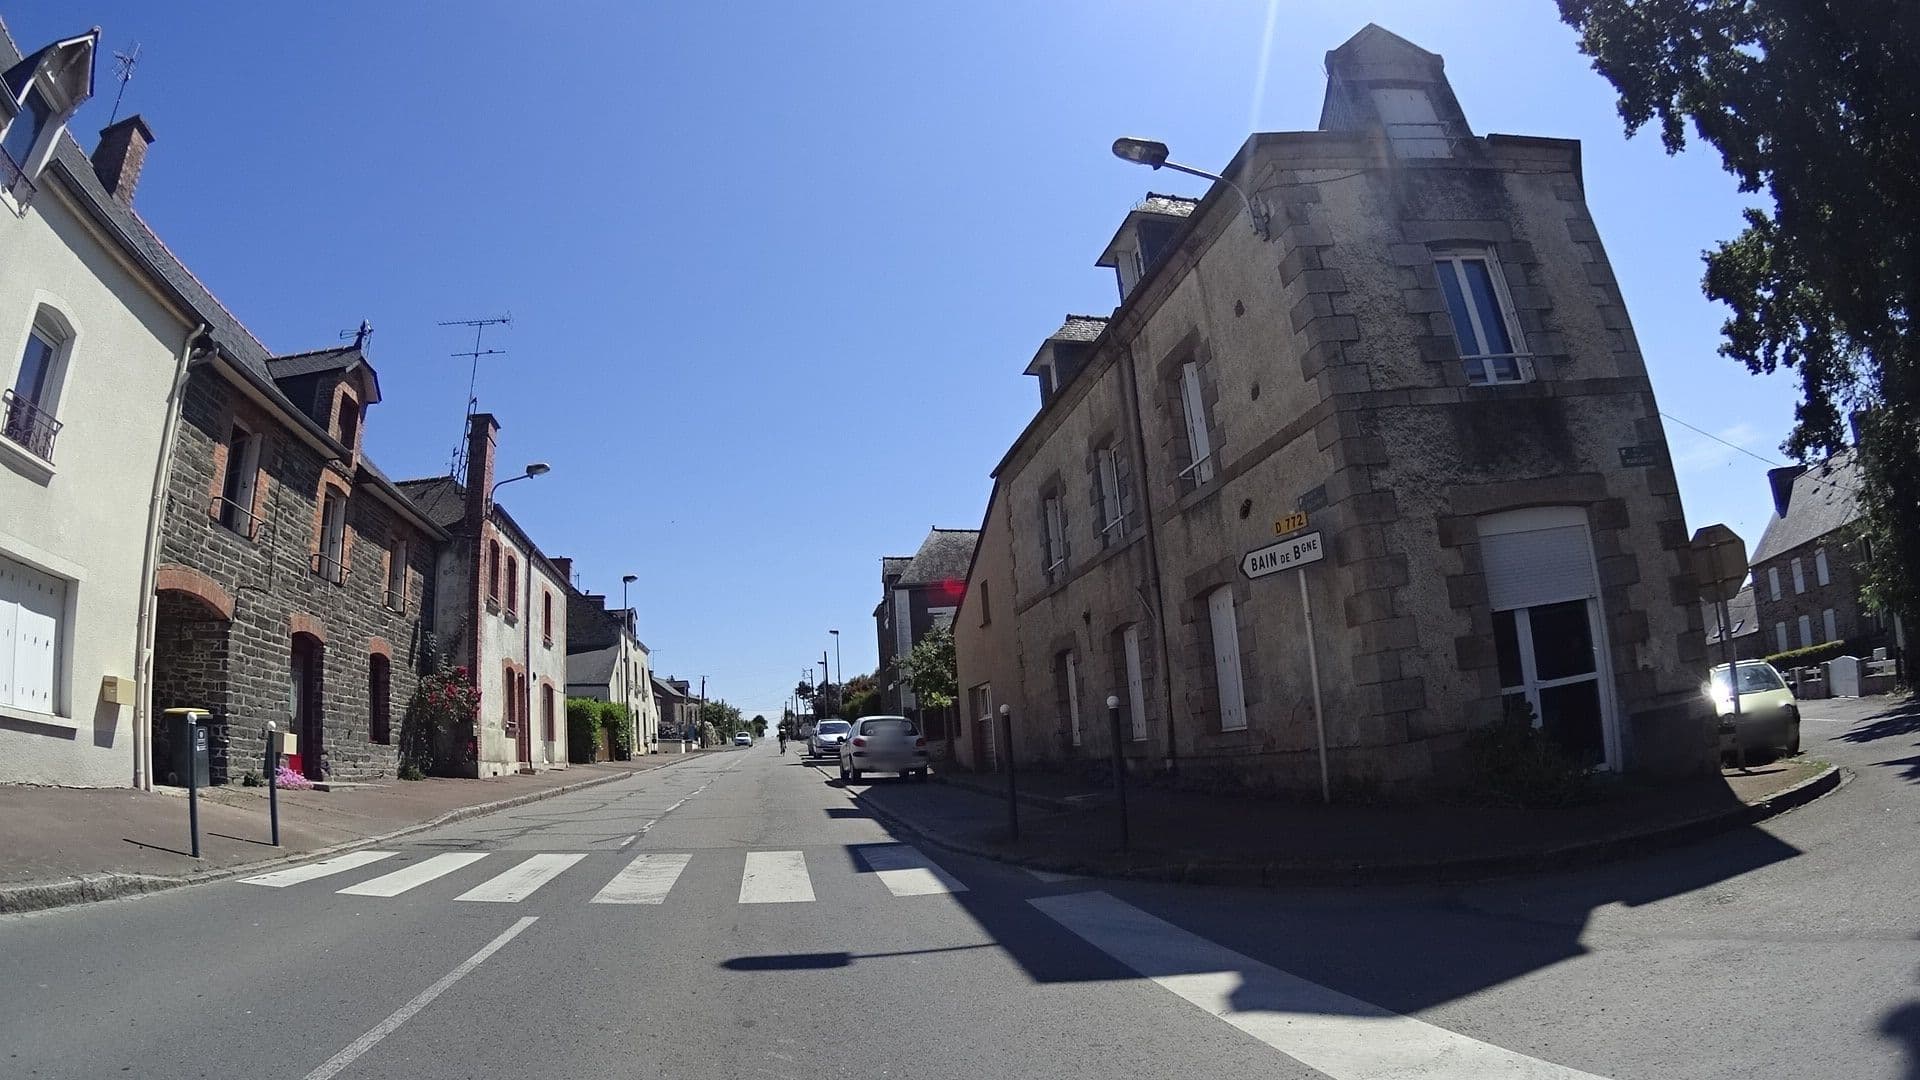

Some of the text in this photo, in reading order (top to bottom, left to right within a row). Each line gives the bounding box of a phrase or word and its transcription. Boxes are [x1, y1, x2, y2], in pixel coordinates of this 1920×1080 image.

[1275, 514, 1304, 534] D 772
[1251, 552, 1277, 572] BAIN
[1280, 552, 1290, 564] DE
